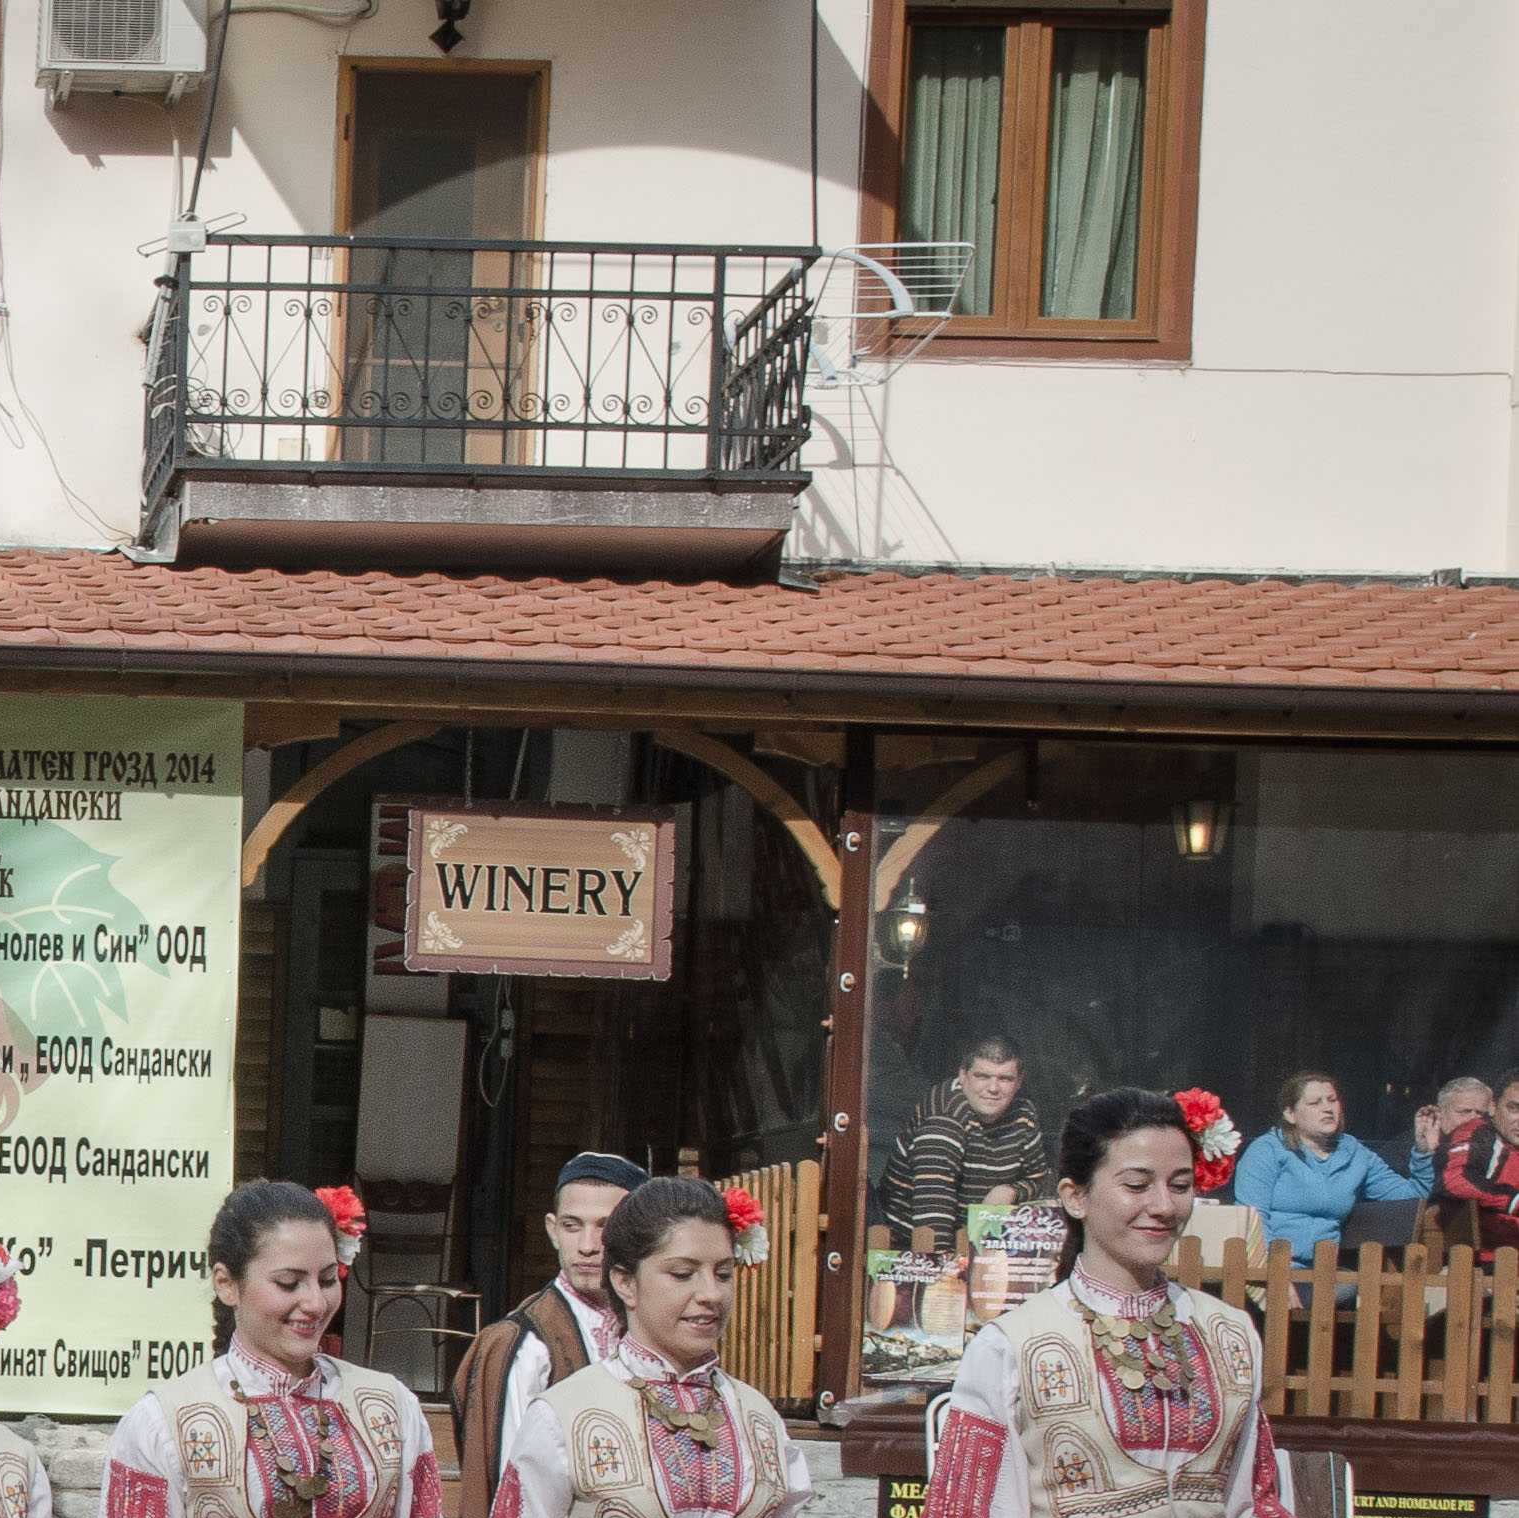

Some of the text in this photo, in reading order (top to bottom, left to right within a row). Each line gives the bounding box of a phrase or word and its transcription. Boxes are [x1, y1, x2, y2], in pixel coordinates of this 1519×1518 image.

[82, 750, 157, 788] ГРОЗД
[165, 752, 216, 784] 2014
[435, 861, 644, 918] WINERY
[72, 934, 85, 962] и
[156, 924, 207, 972] ООД
[36, 1035, 93, 1083] ЕООД
[100, 1036, 212, 1084] Сандански
[75, 1136, 210, 1185] Сандански
[1375, 1495, 1397, 1508] AND
[1398, 1496, 1457, 1511] HOMEMADE
